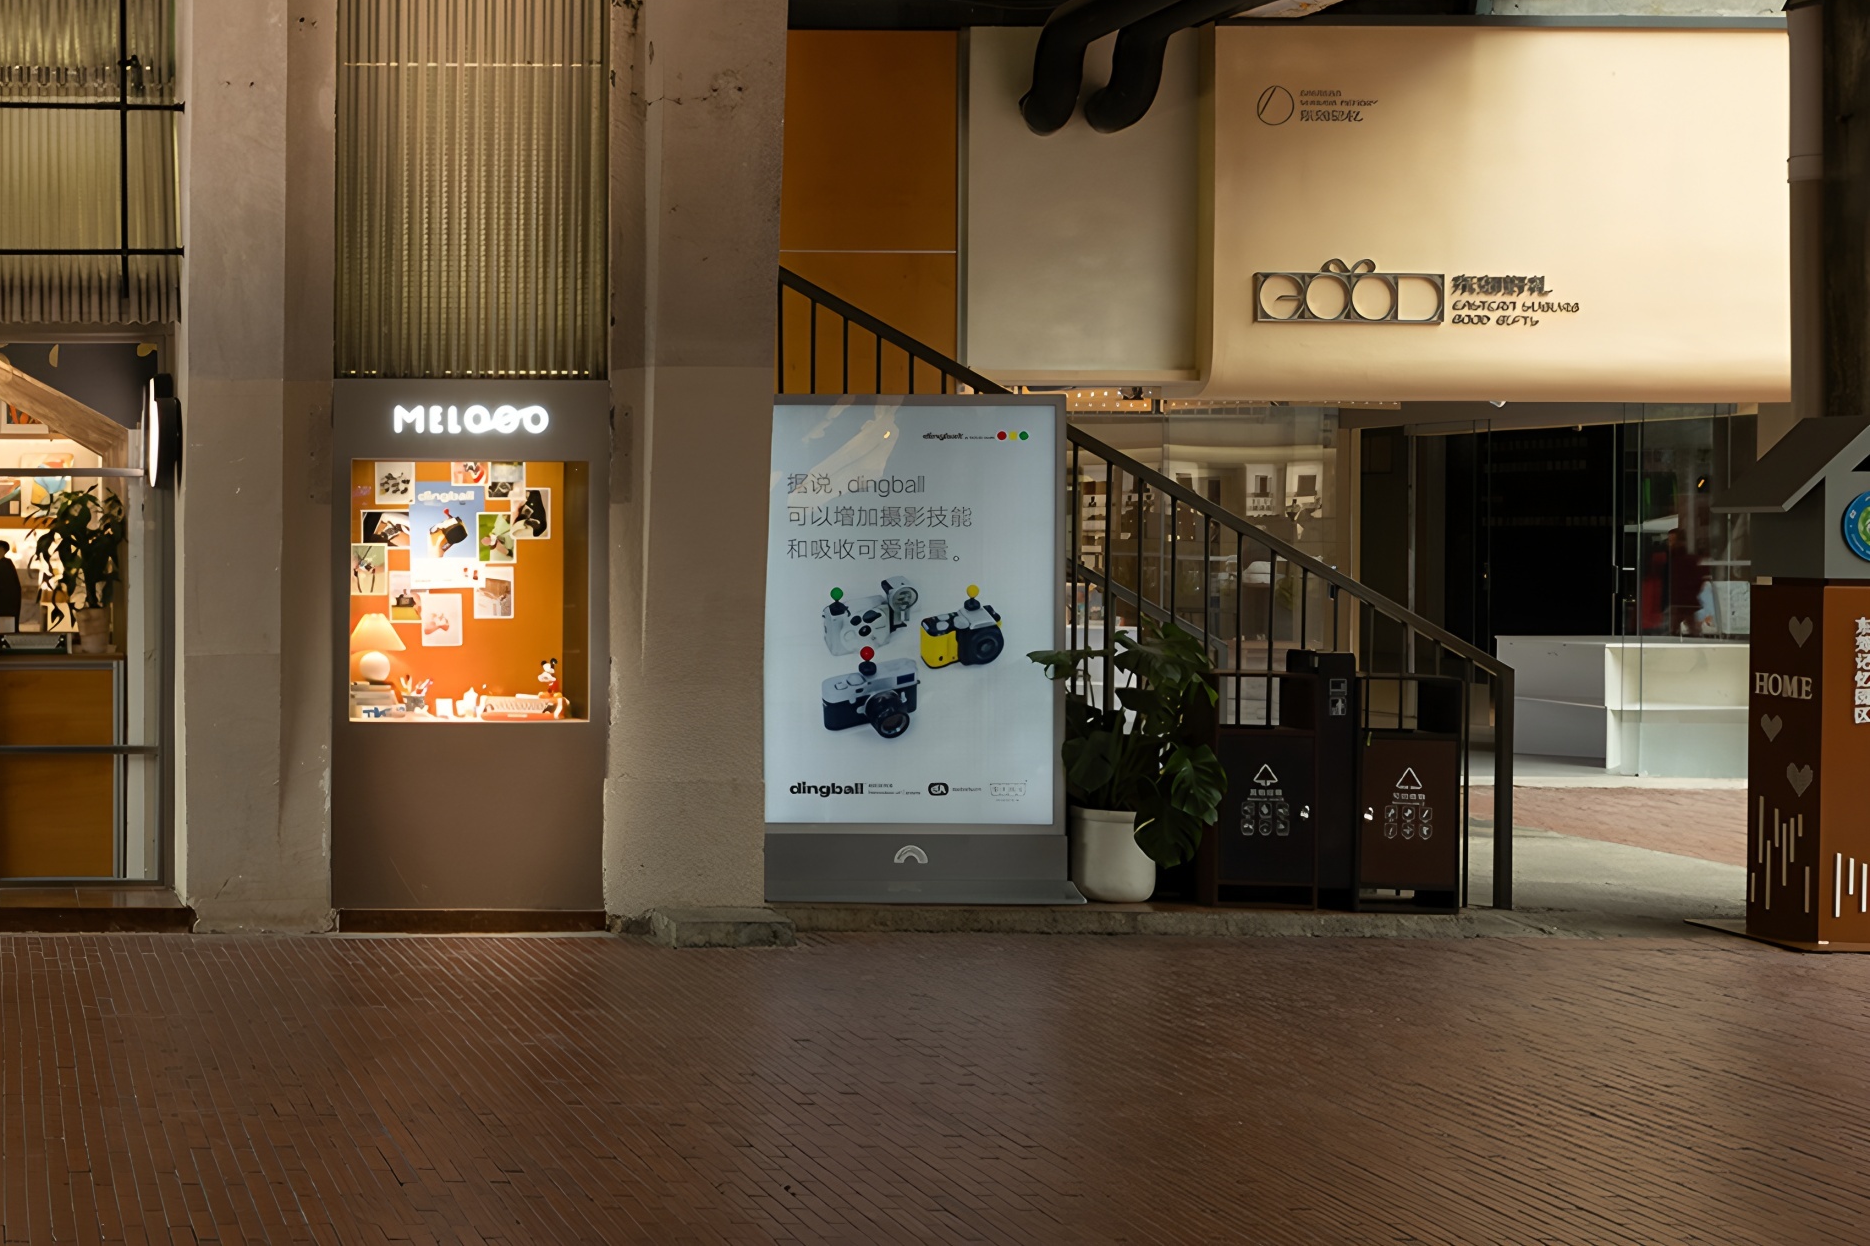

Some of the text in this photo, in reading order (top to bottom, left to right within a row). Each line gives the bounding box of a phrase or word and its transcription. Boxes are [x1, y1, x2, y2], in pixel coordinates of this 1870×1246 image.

[847, 475, 926, 498] dingball
[786, 505, 973, 529] 可以增加摄影技能
[1754, 672, 1813, 700] HOME
[789, 782, 864, 798] dingball
